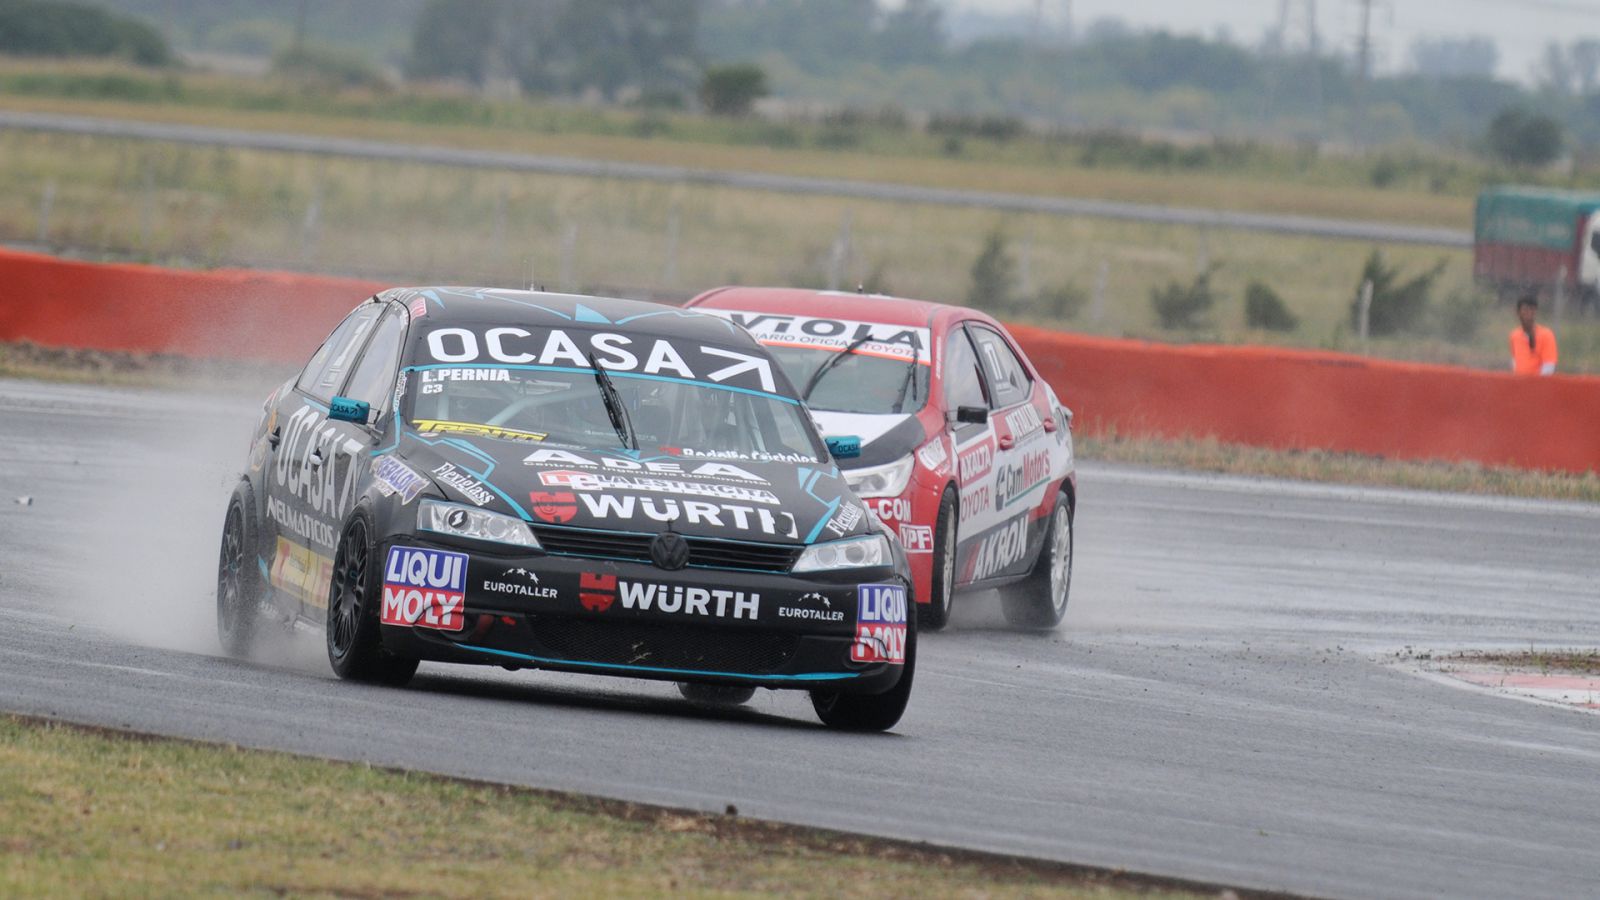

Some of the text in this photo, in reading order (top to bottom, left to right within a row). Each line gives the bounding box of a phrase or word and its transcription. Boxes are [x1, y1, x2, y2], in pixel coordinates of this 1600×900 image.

[730, 313, 925, 351] VIOLA
[799, 336, 849, 347] OFICIA
[426, 327, 696, 380] OCASA
[422, 383, 443, 394] C3
[277, 404, 346, 519] OCASA
[522, 449, 767, 482] ADEA
[523, 461, 576, 469] Centro
[960, 443, 992, 483] AXALTA
[431, 461, 496, 506] Flexiglass
[578, 493, 799, 540] WÜRTH
[960, 484, 990, 523] OYOTA
[901, 527, 930, 550] YPF
[970, 514, 1030, 585] AKRON
[386, 549, 464, 590] LIQUI
[382, 586, 463, 626] MOLY
[483, 580, 559, 599] EUROTALLER
[618, 580, 761, 621] WÜRTH
[778, 606, 845, 622] EUROTALLER
[856, 625, 907, 661] MOLY
